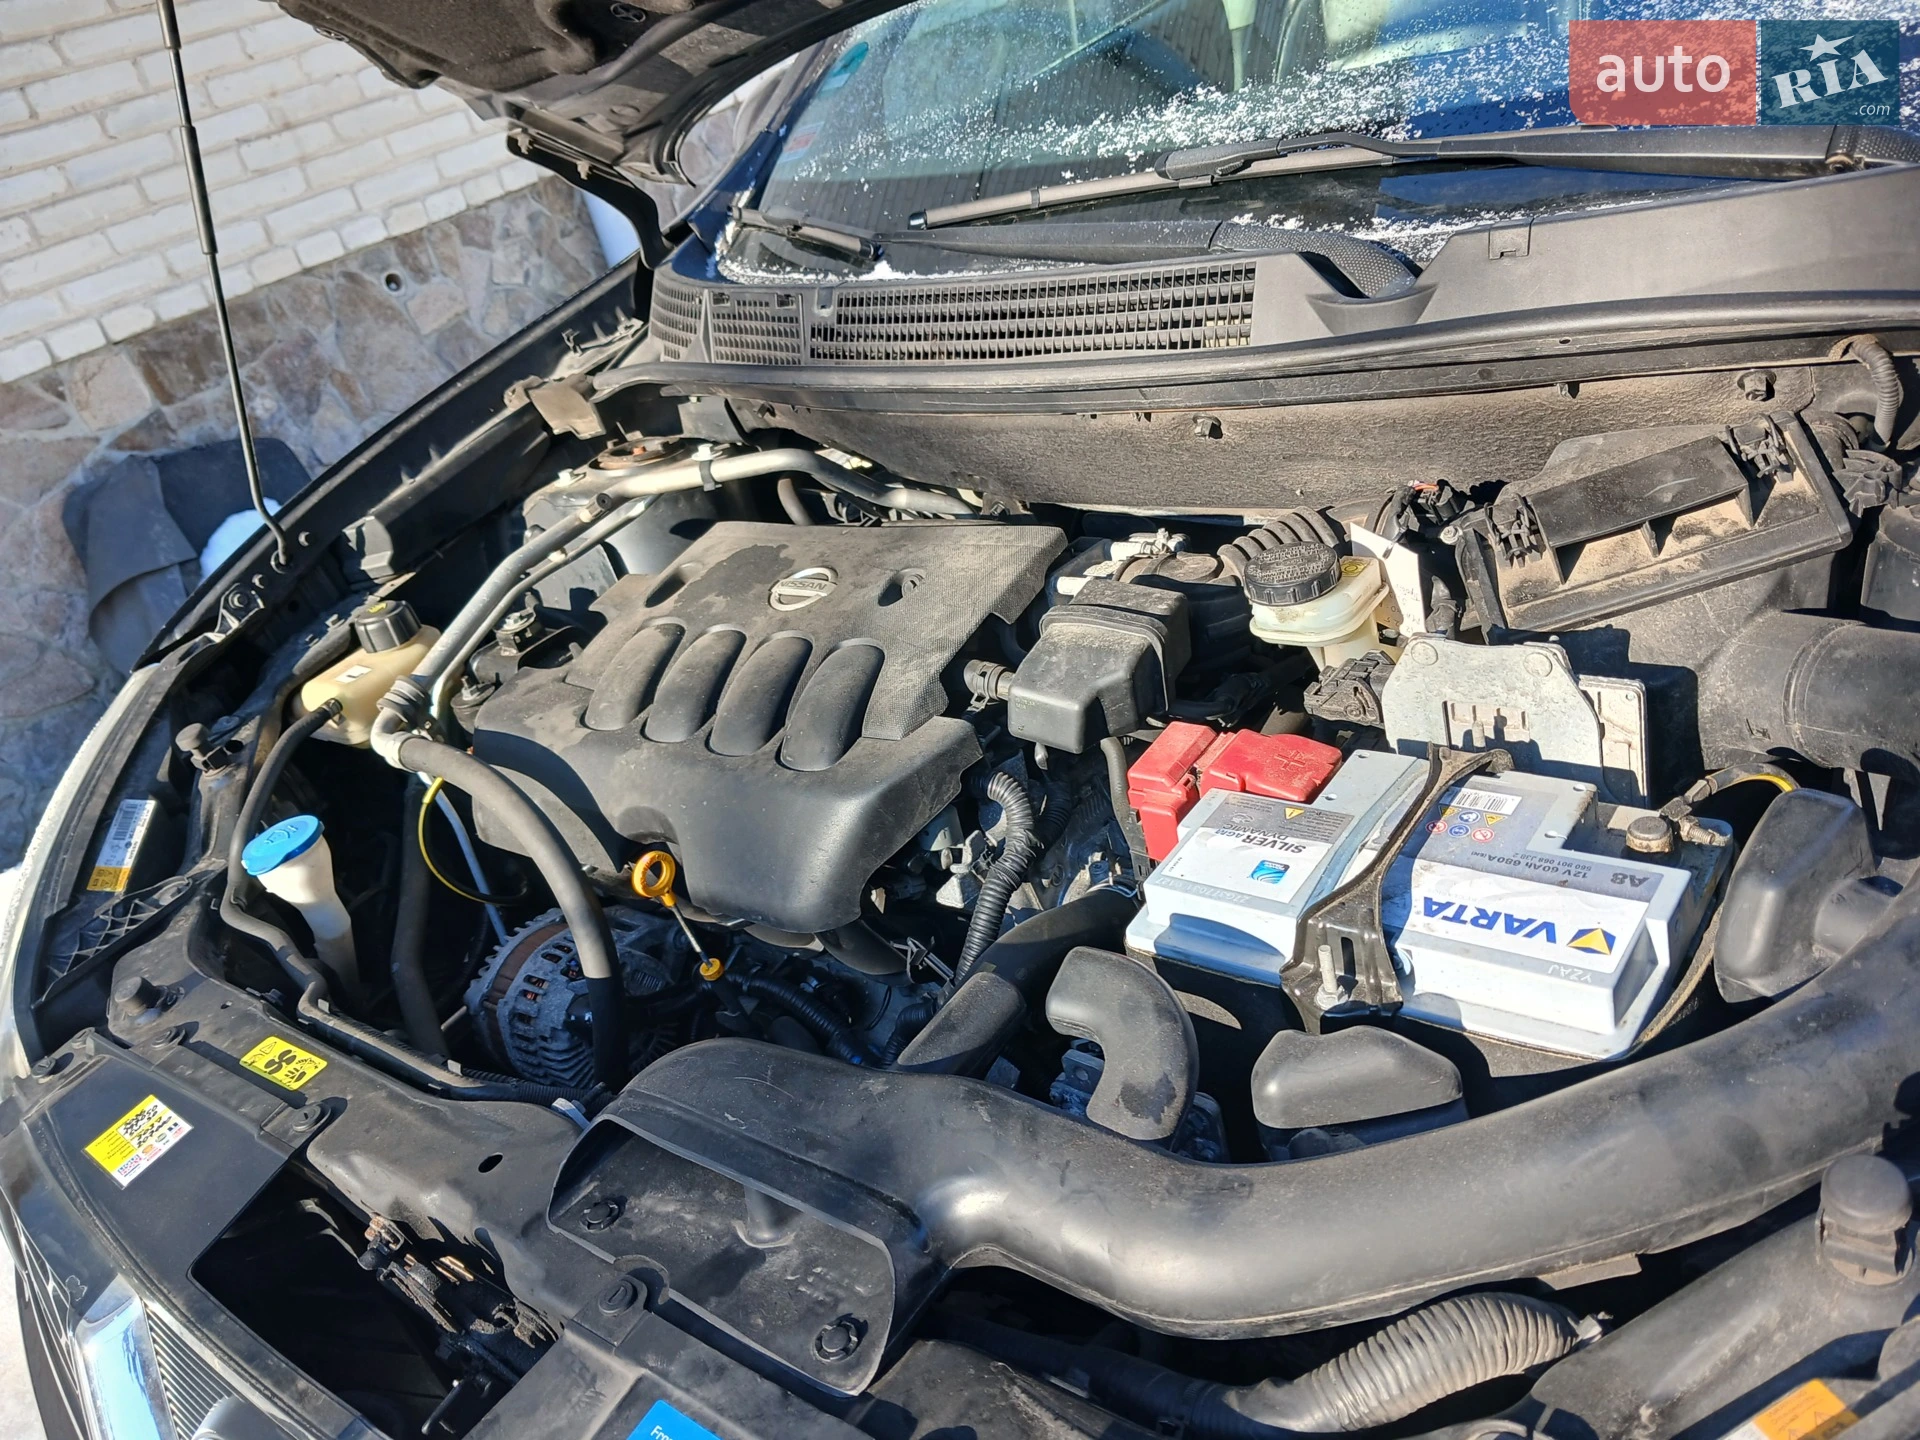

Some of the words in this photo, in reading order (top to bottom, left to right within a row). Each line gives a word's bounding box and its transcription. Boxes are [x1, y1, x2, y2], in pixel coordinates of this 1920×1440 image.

[780, 580, 827, 590] NISSAN
[1214, 829, 1241, 839] AGM
[1222, 823, 1289, 840] DYNAMIC
[1242, 835, 1307, 853] SILVER
[1525, 862, 1559, 874] 60Ah
[1562, 870, 1588, 879] 12V
[1610, 872, 1650, 888] A8
[1423, 896, 1557, 944] VARTA
